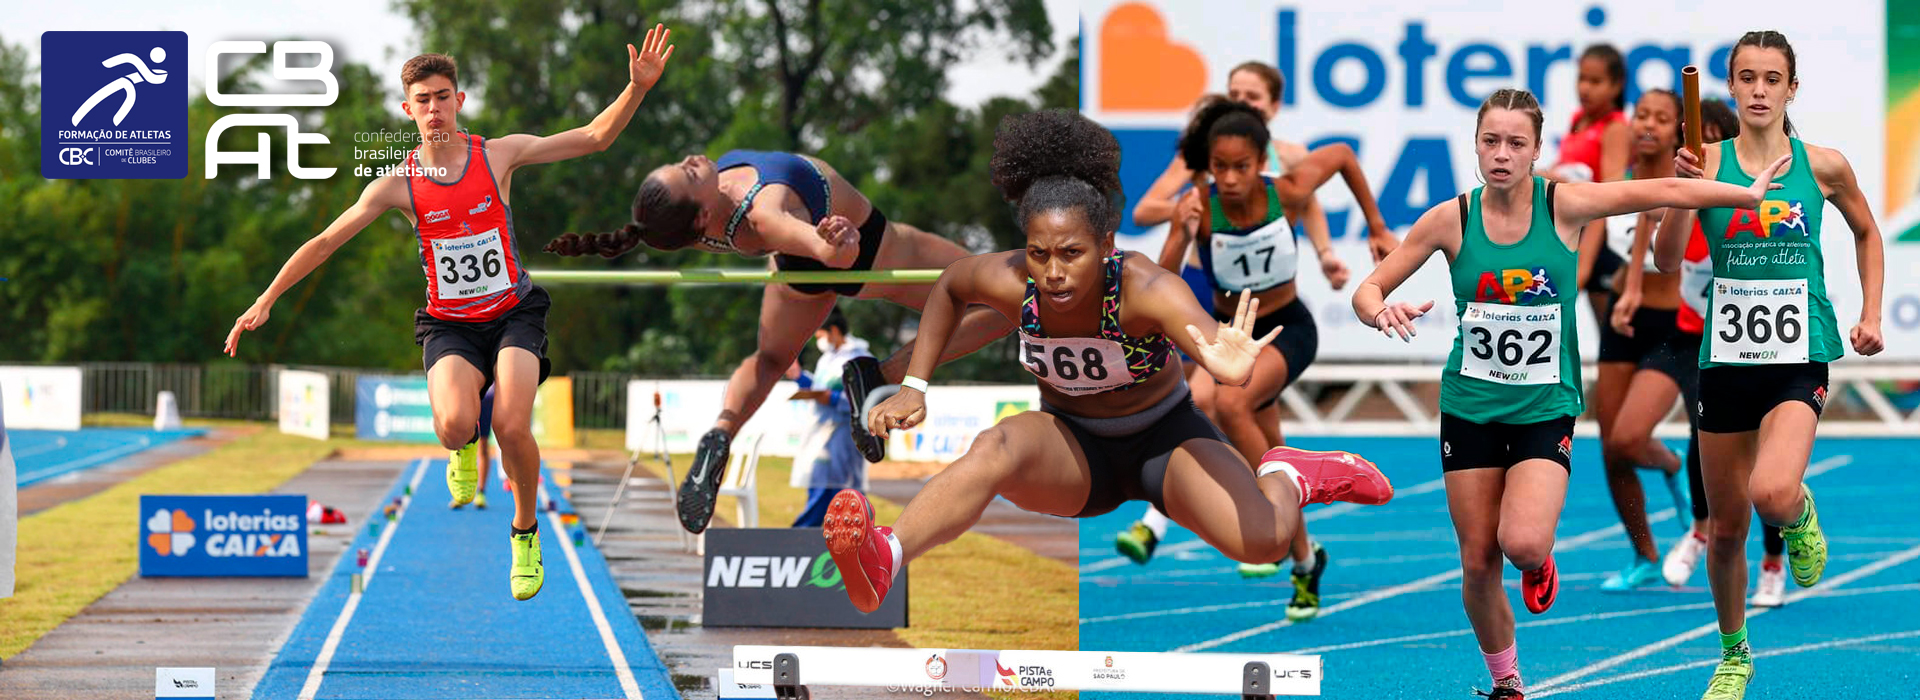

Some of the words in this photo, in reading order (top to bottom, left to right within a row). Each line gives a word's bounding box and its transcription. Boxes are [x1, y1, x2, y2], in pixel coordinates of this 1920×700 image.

[445, 242, 475, 251] loterias
[477, 235, 497, 247] CAIXA
[440, 248, 501, 284] 336
[1233, 244, 1276, 277] 17
[1726, 249, 1768, 273] futuro
[1771, 248, 1808, 265] atleta
[1730, 286, 1769, 296] loterias
[1772, 287, 1802, 296] CAIXA
[1482, 310, 1522, 322] loterias
[1525, 313, 1556, 322] CAIXA
[1718, 303, 1802, 344] 366
[1469, 326, 1553, 367] 362
[1024, 341, 1108, 380] 568
[204, 508, 300, 532] loterias
[205, 533, 301, 558] CAIXA
[738, 660, 773, 670] UCS
[1019, 665, 1046, 676] PISTA
[1046, 668, 1053, 676] e
[1020, 676, 1055, 687] CAMPO
